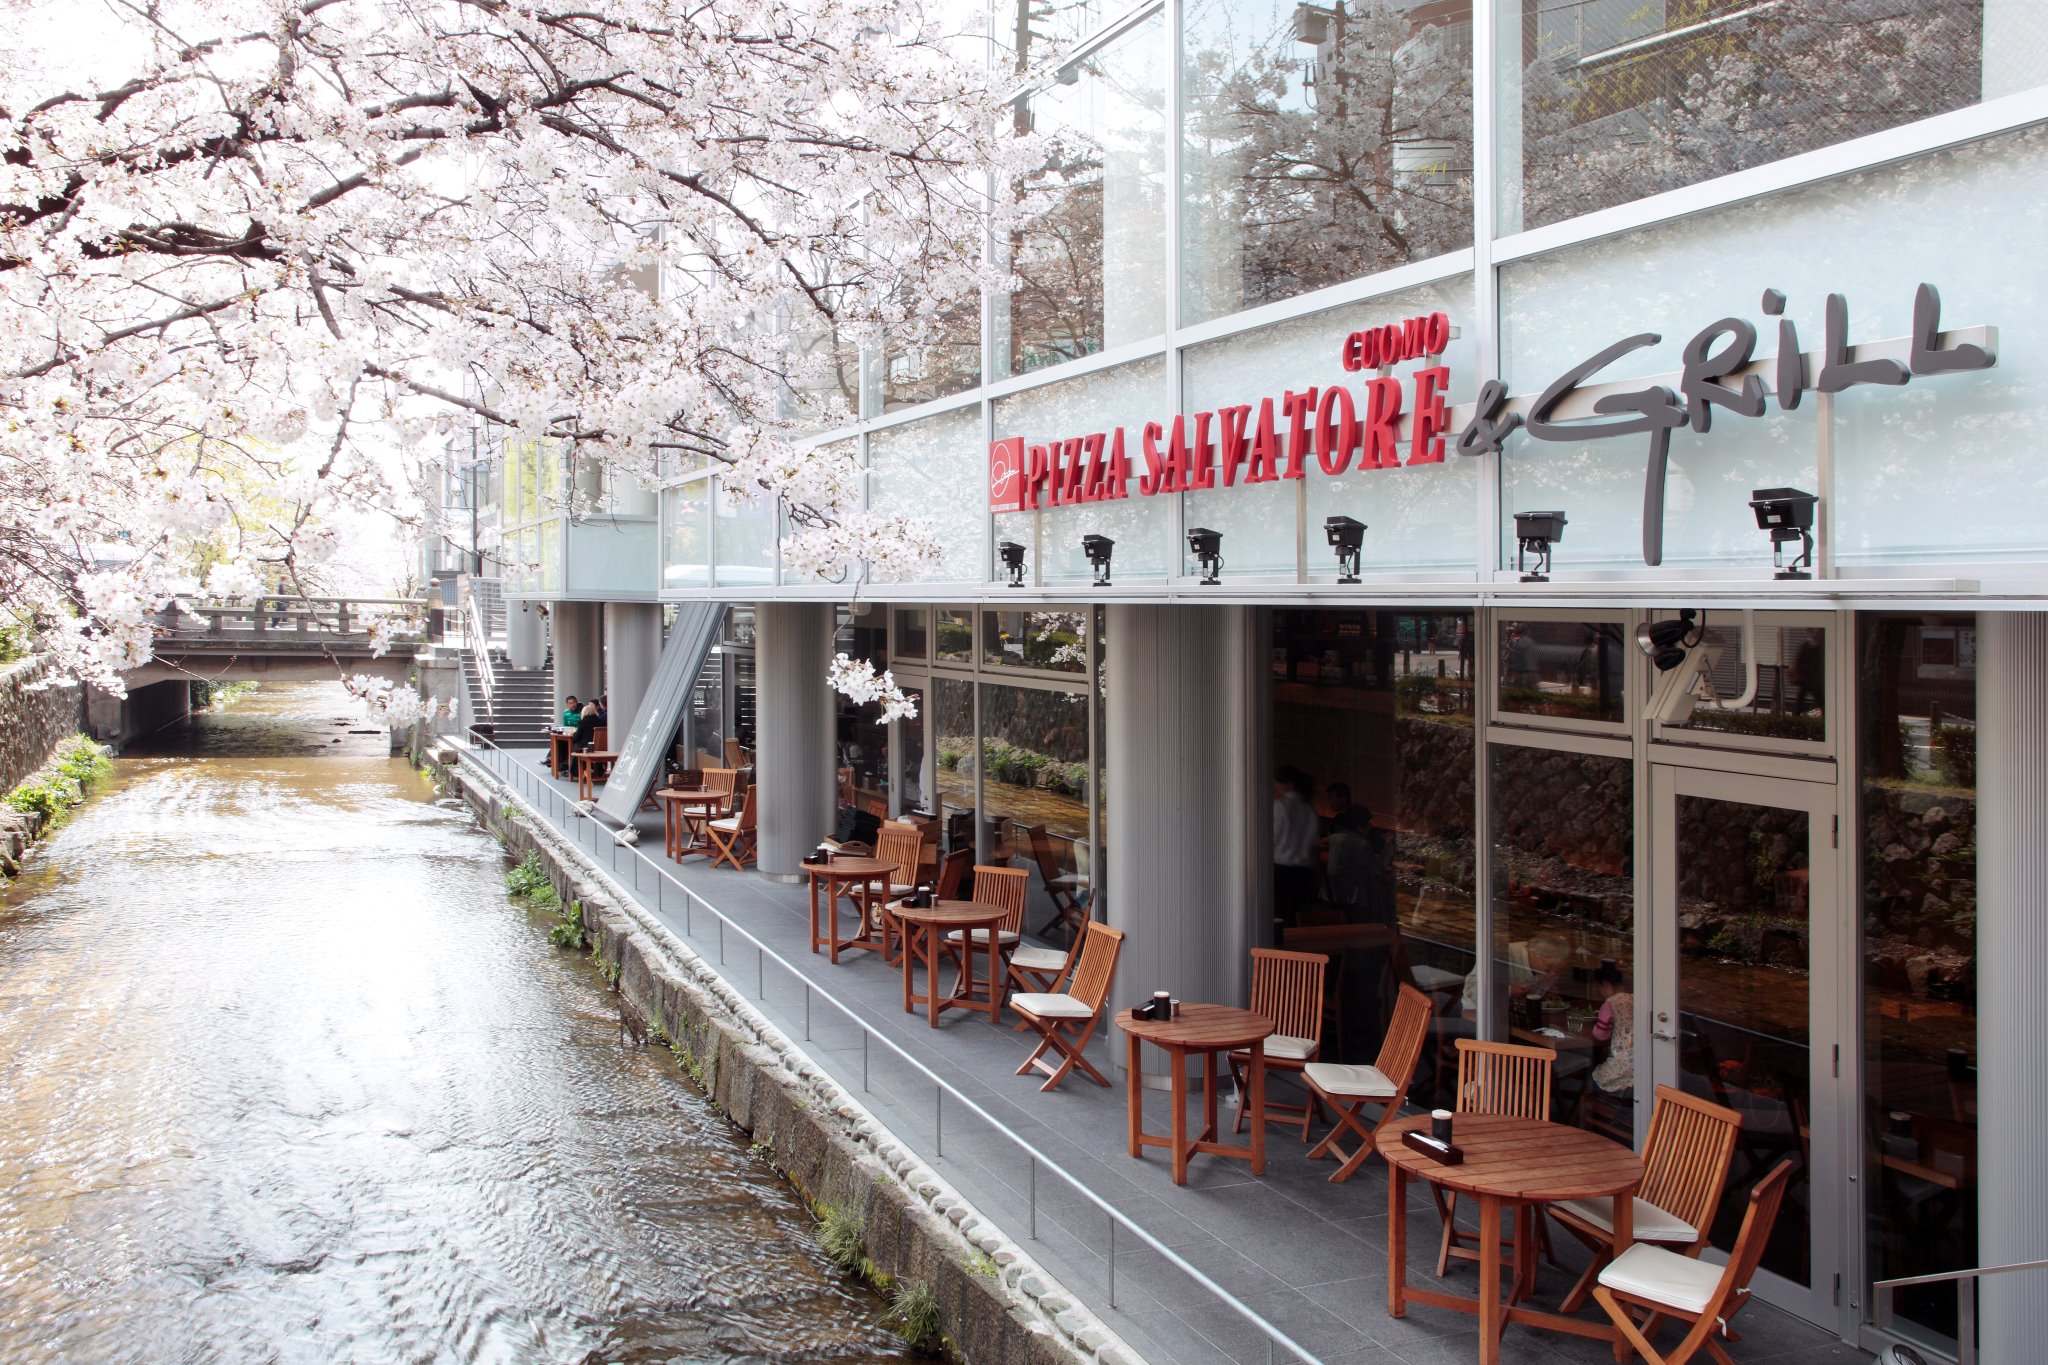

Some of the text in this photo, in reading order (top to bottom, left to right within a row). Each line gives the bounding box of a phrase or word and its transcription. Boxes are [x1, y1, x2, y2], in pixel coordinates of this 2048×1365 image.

[1343, 312, 1450, 372] CUOMO
[1025, 427, 1128, 510] PIZZA
[1140, 366, 1450, 496] SALVATORE
[1456, 379, 1520, 456] &
